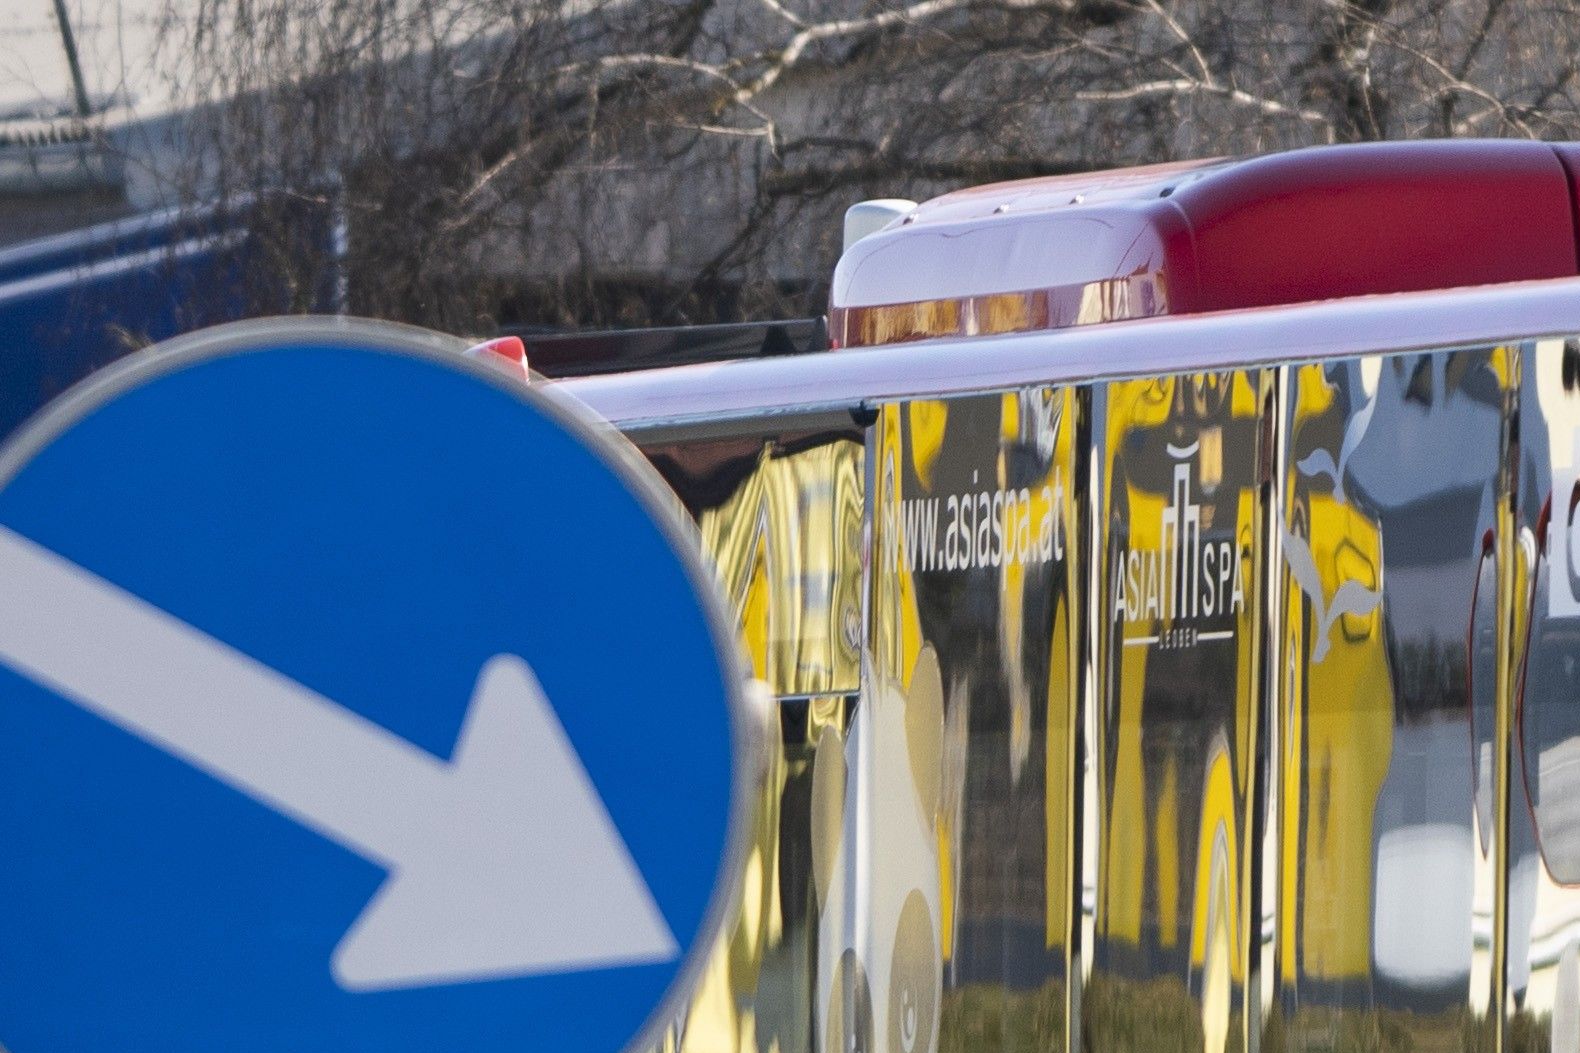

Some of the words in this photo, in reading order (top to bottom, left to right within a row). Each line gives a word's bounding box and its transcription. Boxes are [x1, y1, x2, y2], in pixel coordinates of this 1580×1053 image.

[884, 467, 1063, 590] www.asiaspa.at
[1114, 550, 1159, 622] ASIA
[1203, 541, 1245, 617] SPA
